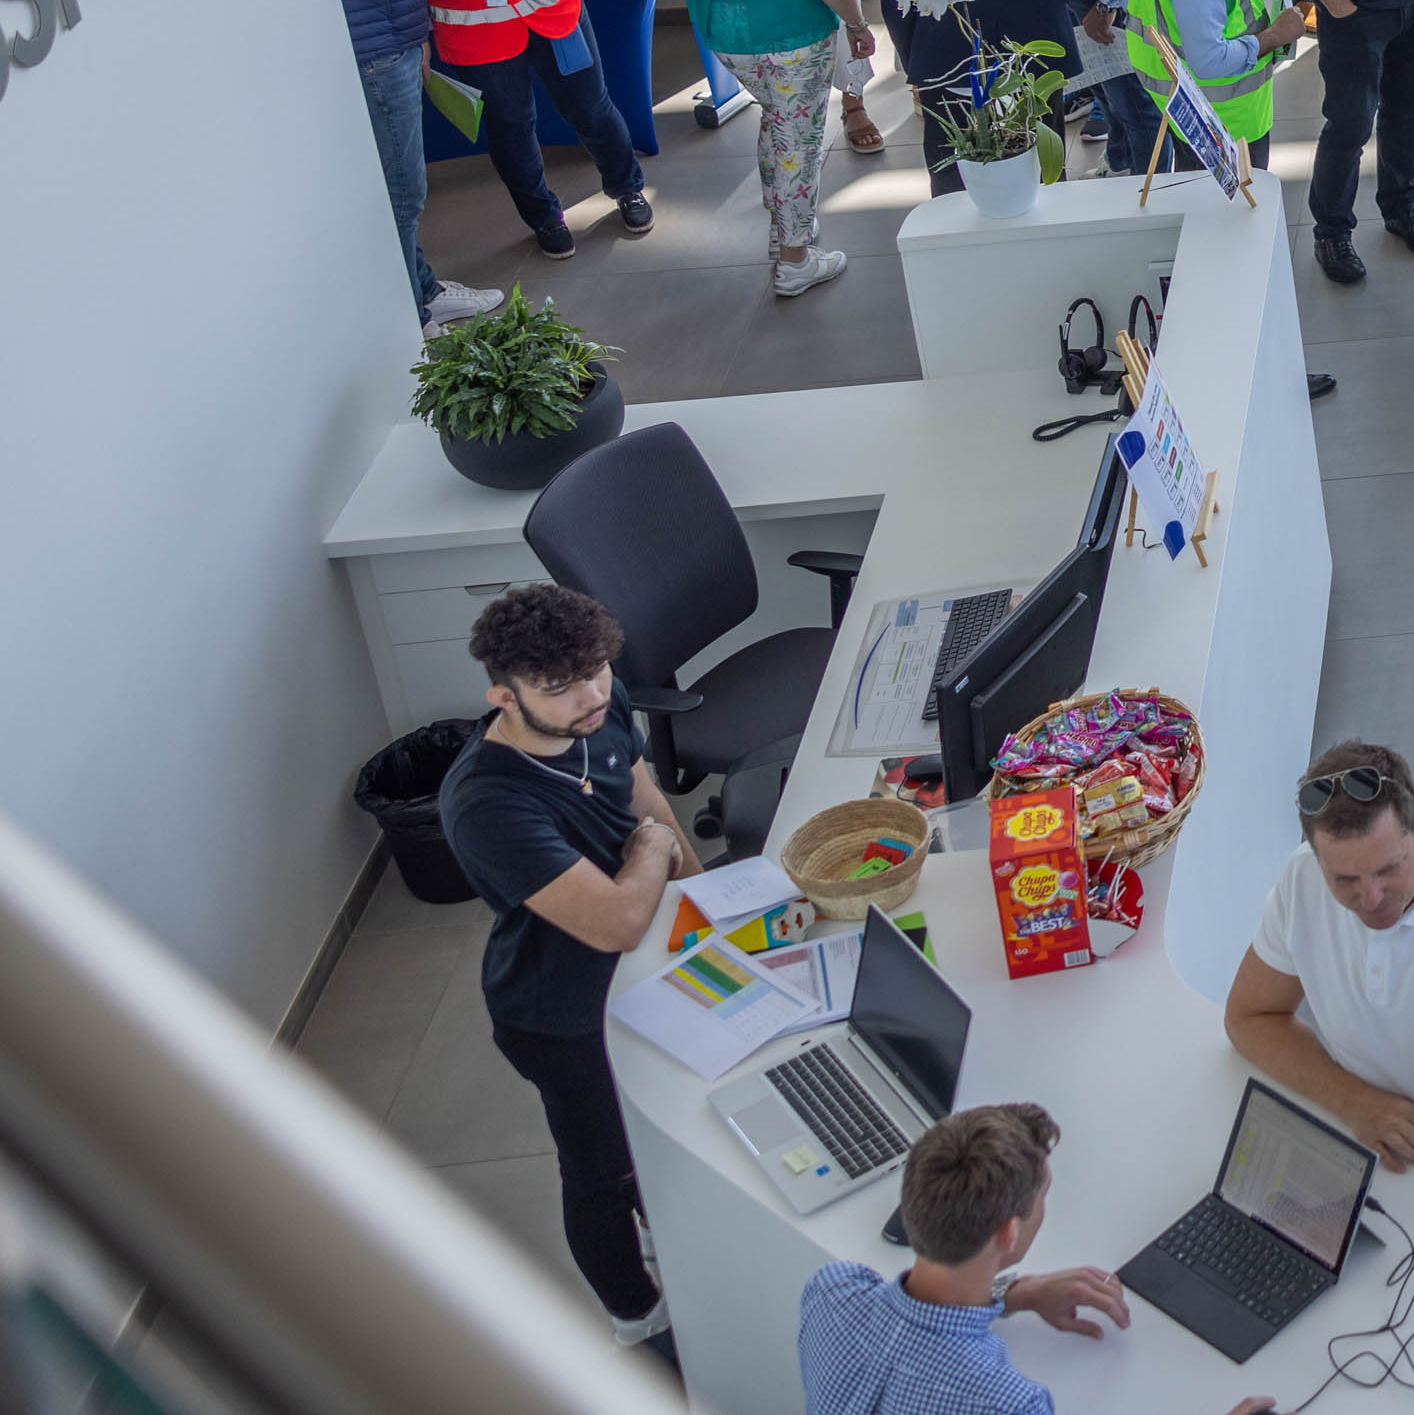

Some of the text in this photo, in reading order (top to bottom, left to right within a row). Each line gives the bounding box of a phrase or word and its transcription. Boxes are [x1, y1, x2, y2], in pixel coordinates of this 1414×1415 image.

[1018, 873, 1056, 887] Chupa
[1017, 884, 1056, 901] Chups
[1030, 917, 1064, 934] BEST
